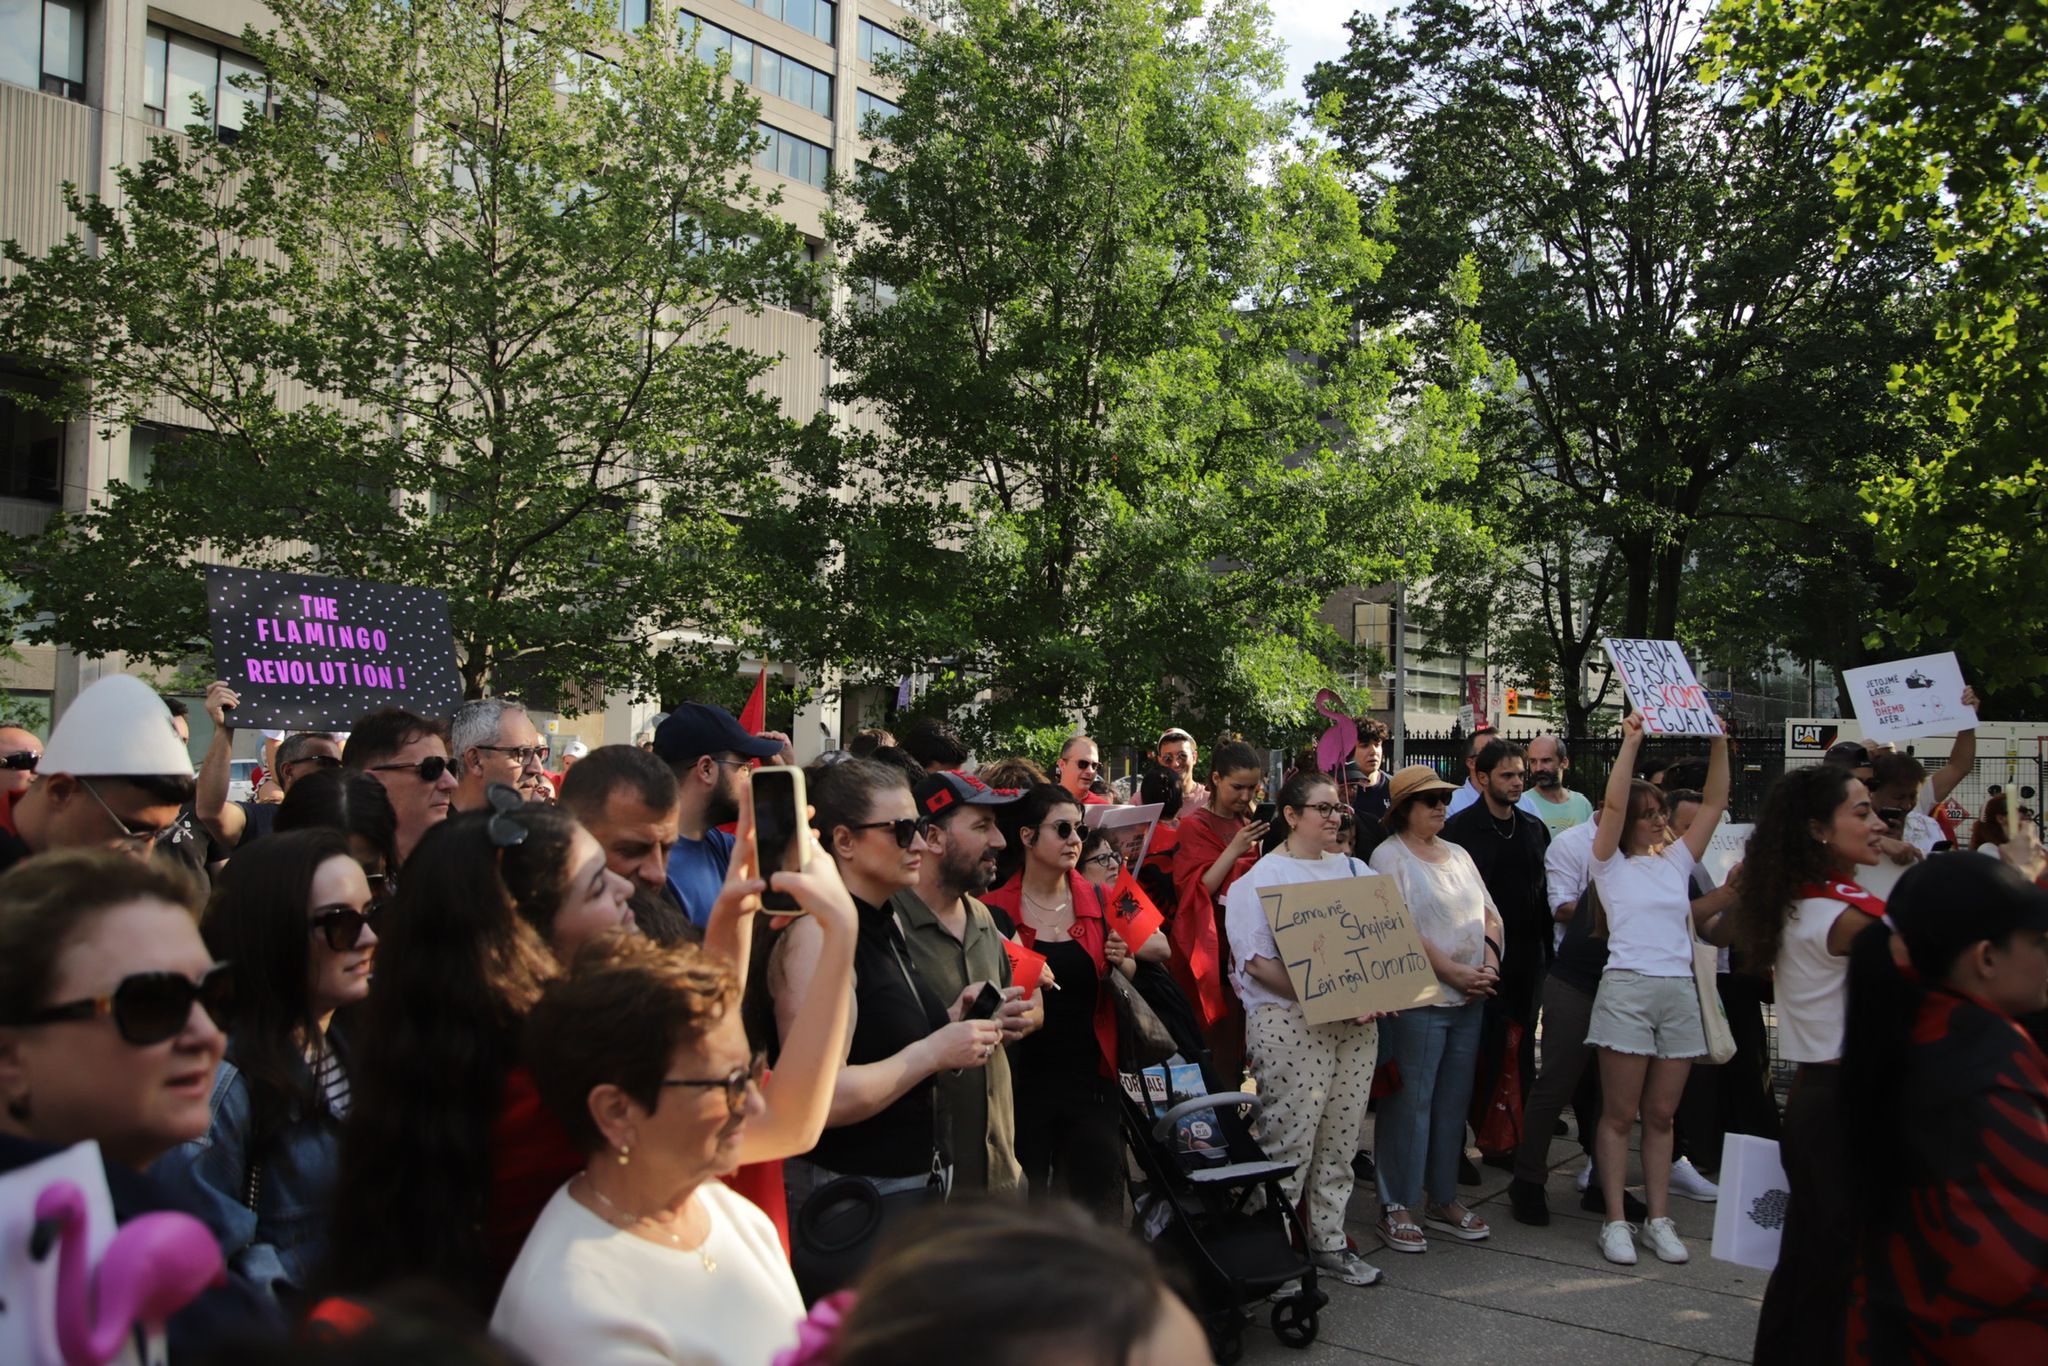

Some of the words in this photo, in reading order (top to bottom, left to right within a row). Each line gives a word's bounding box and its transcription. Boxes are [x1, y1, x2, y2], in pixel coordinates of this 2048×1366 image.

[299, 594, 340, 621] THE
[256, 618, 388, 652] FLAMINGO
[1609, 638, 1678, 663] RRENA
[246, 658, 408, 690] REVOLUTION!
[1622, 660, 1687, 685] PASKA
[1872, 698, 1886, 707] NA
[1875, 703, 1905, 716] DHEMB
[1657, 707, 1720, 734] GJATA
[1794, 726, 1822, 743] CAT
[1946, 809, 1961, 819] 202
[1260, 893, 1327, 932] Zemra
[1329, 900, 1347, 917] në
[1340, 911, 1405, 944] Shqipëri
[1287, 957, 1337, 1001] Zëri
[1344, 943, 1427, 983] Toronto
[1146, 1076, 1164, 1093] ALE
